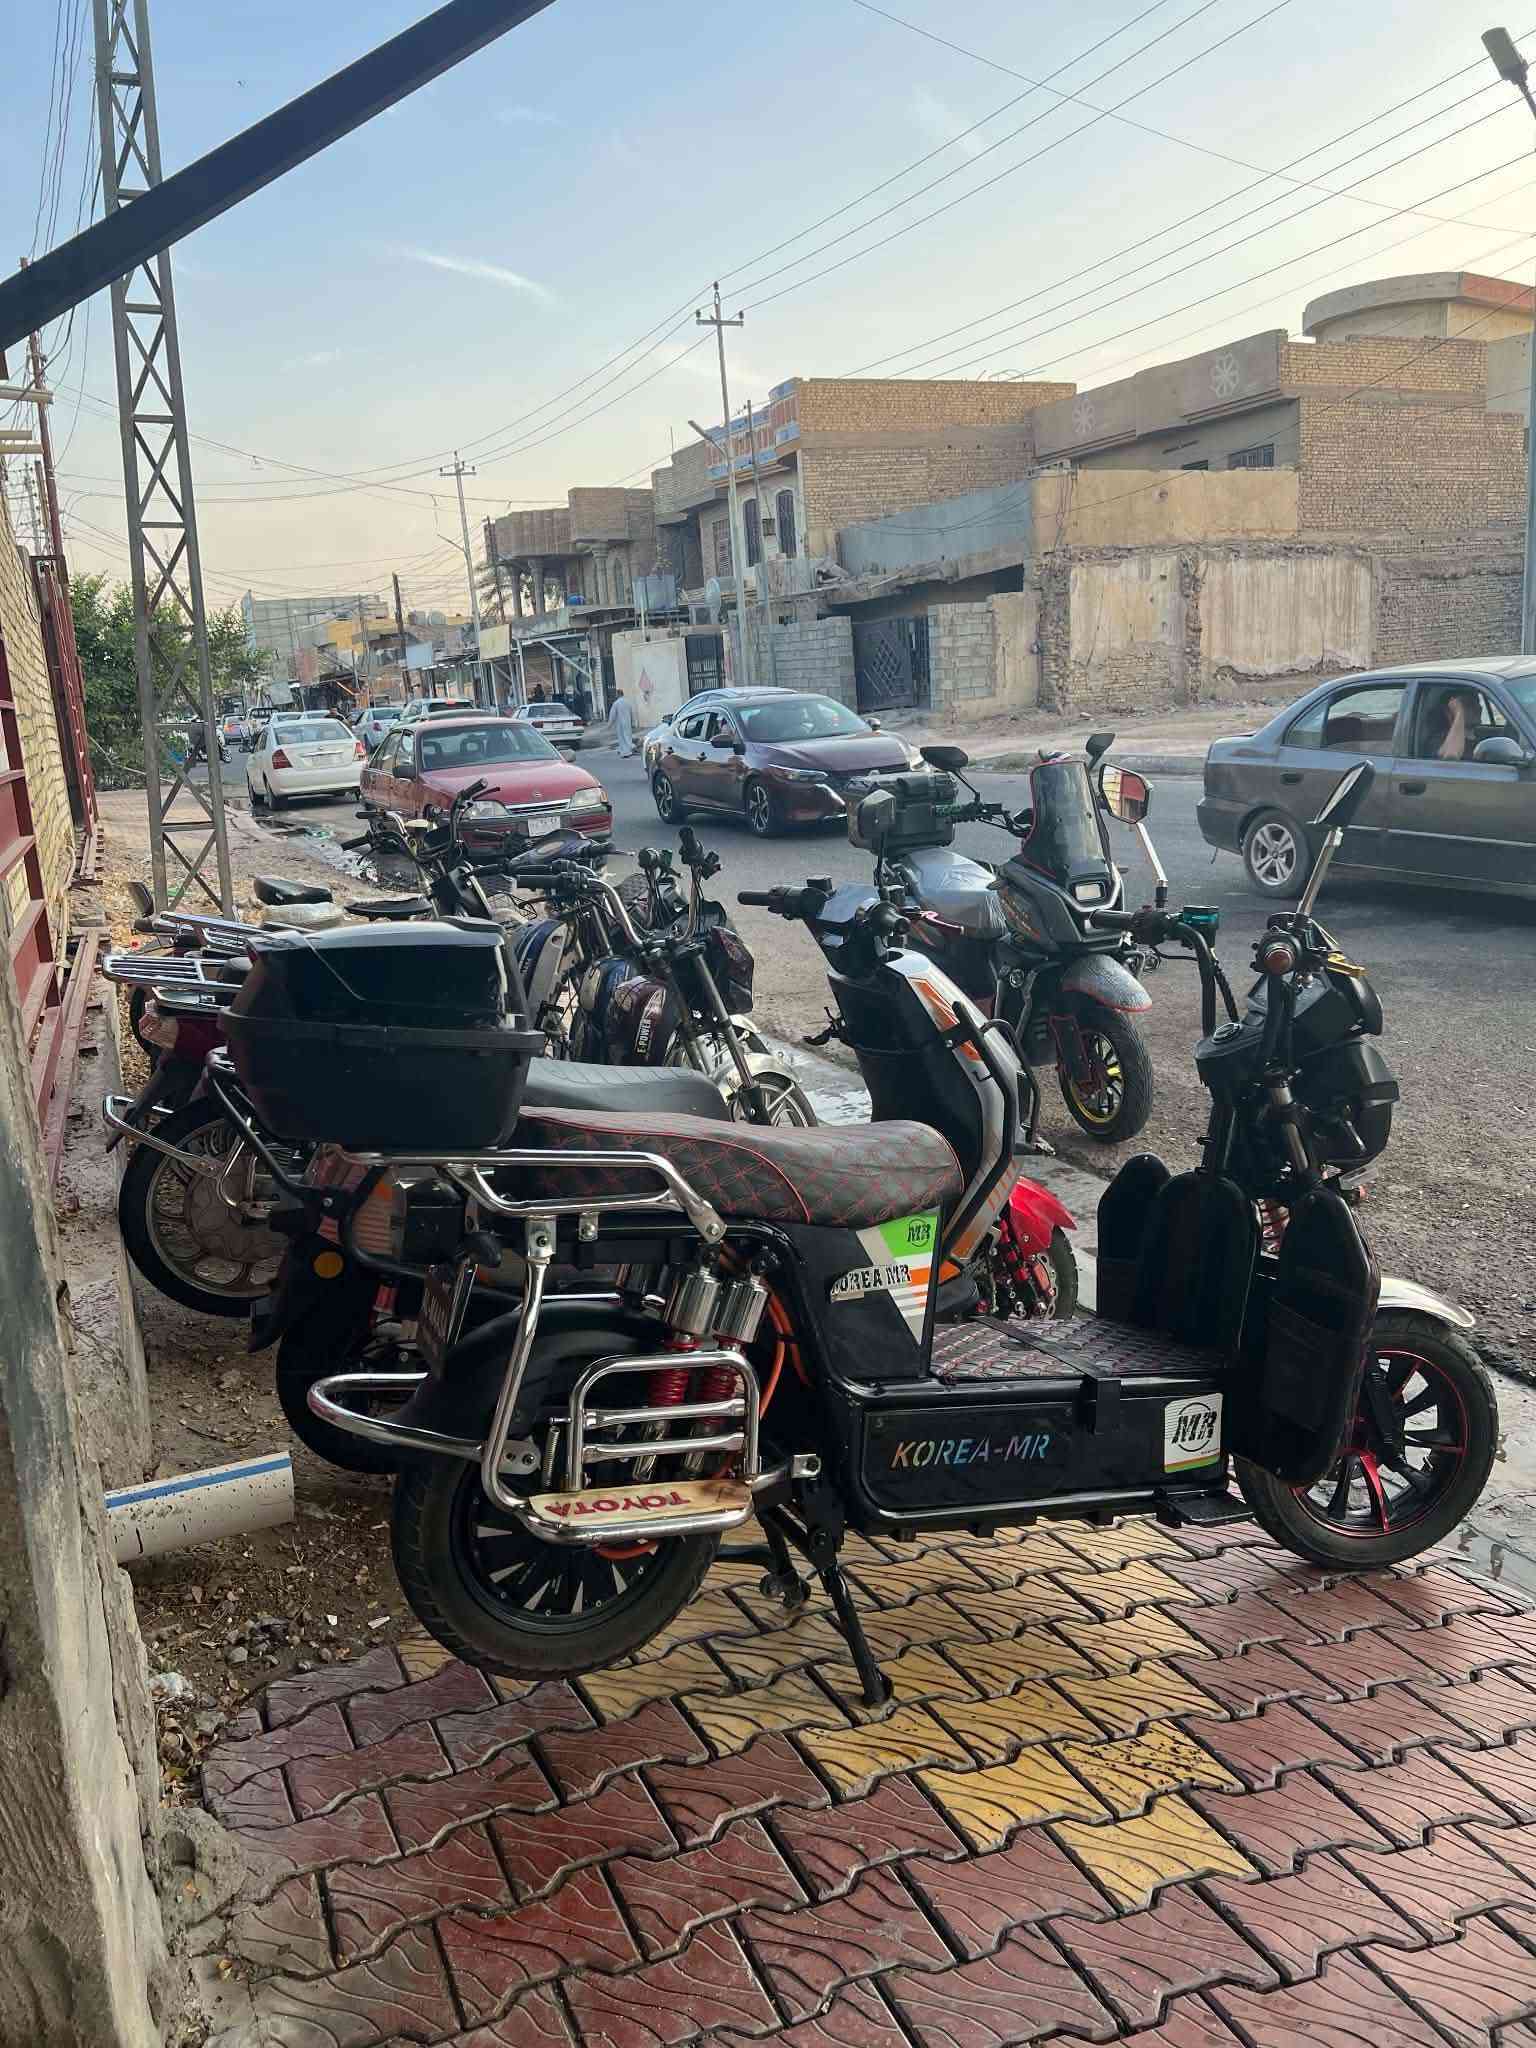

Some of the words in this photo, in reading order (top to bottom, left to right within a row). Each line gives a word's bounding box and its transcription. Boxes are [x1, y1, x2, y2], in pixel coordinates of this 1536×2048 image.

[636, 1018, 652, 1054] E-POWER
[907, 1223, 932, 1242] MR
[885, 1263, 912, 1285] MR
[1171, 1411, 1217, 1444] MR
[890, 1433, 1051, 1469] KOREA-MR
[544, 1491, 690, 1518] TOYOTA
